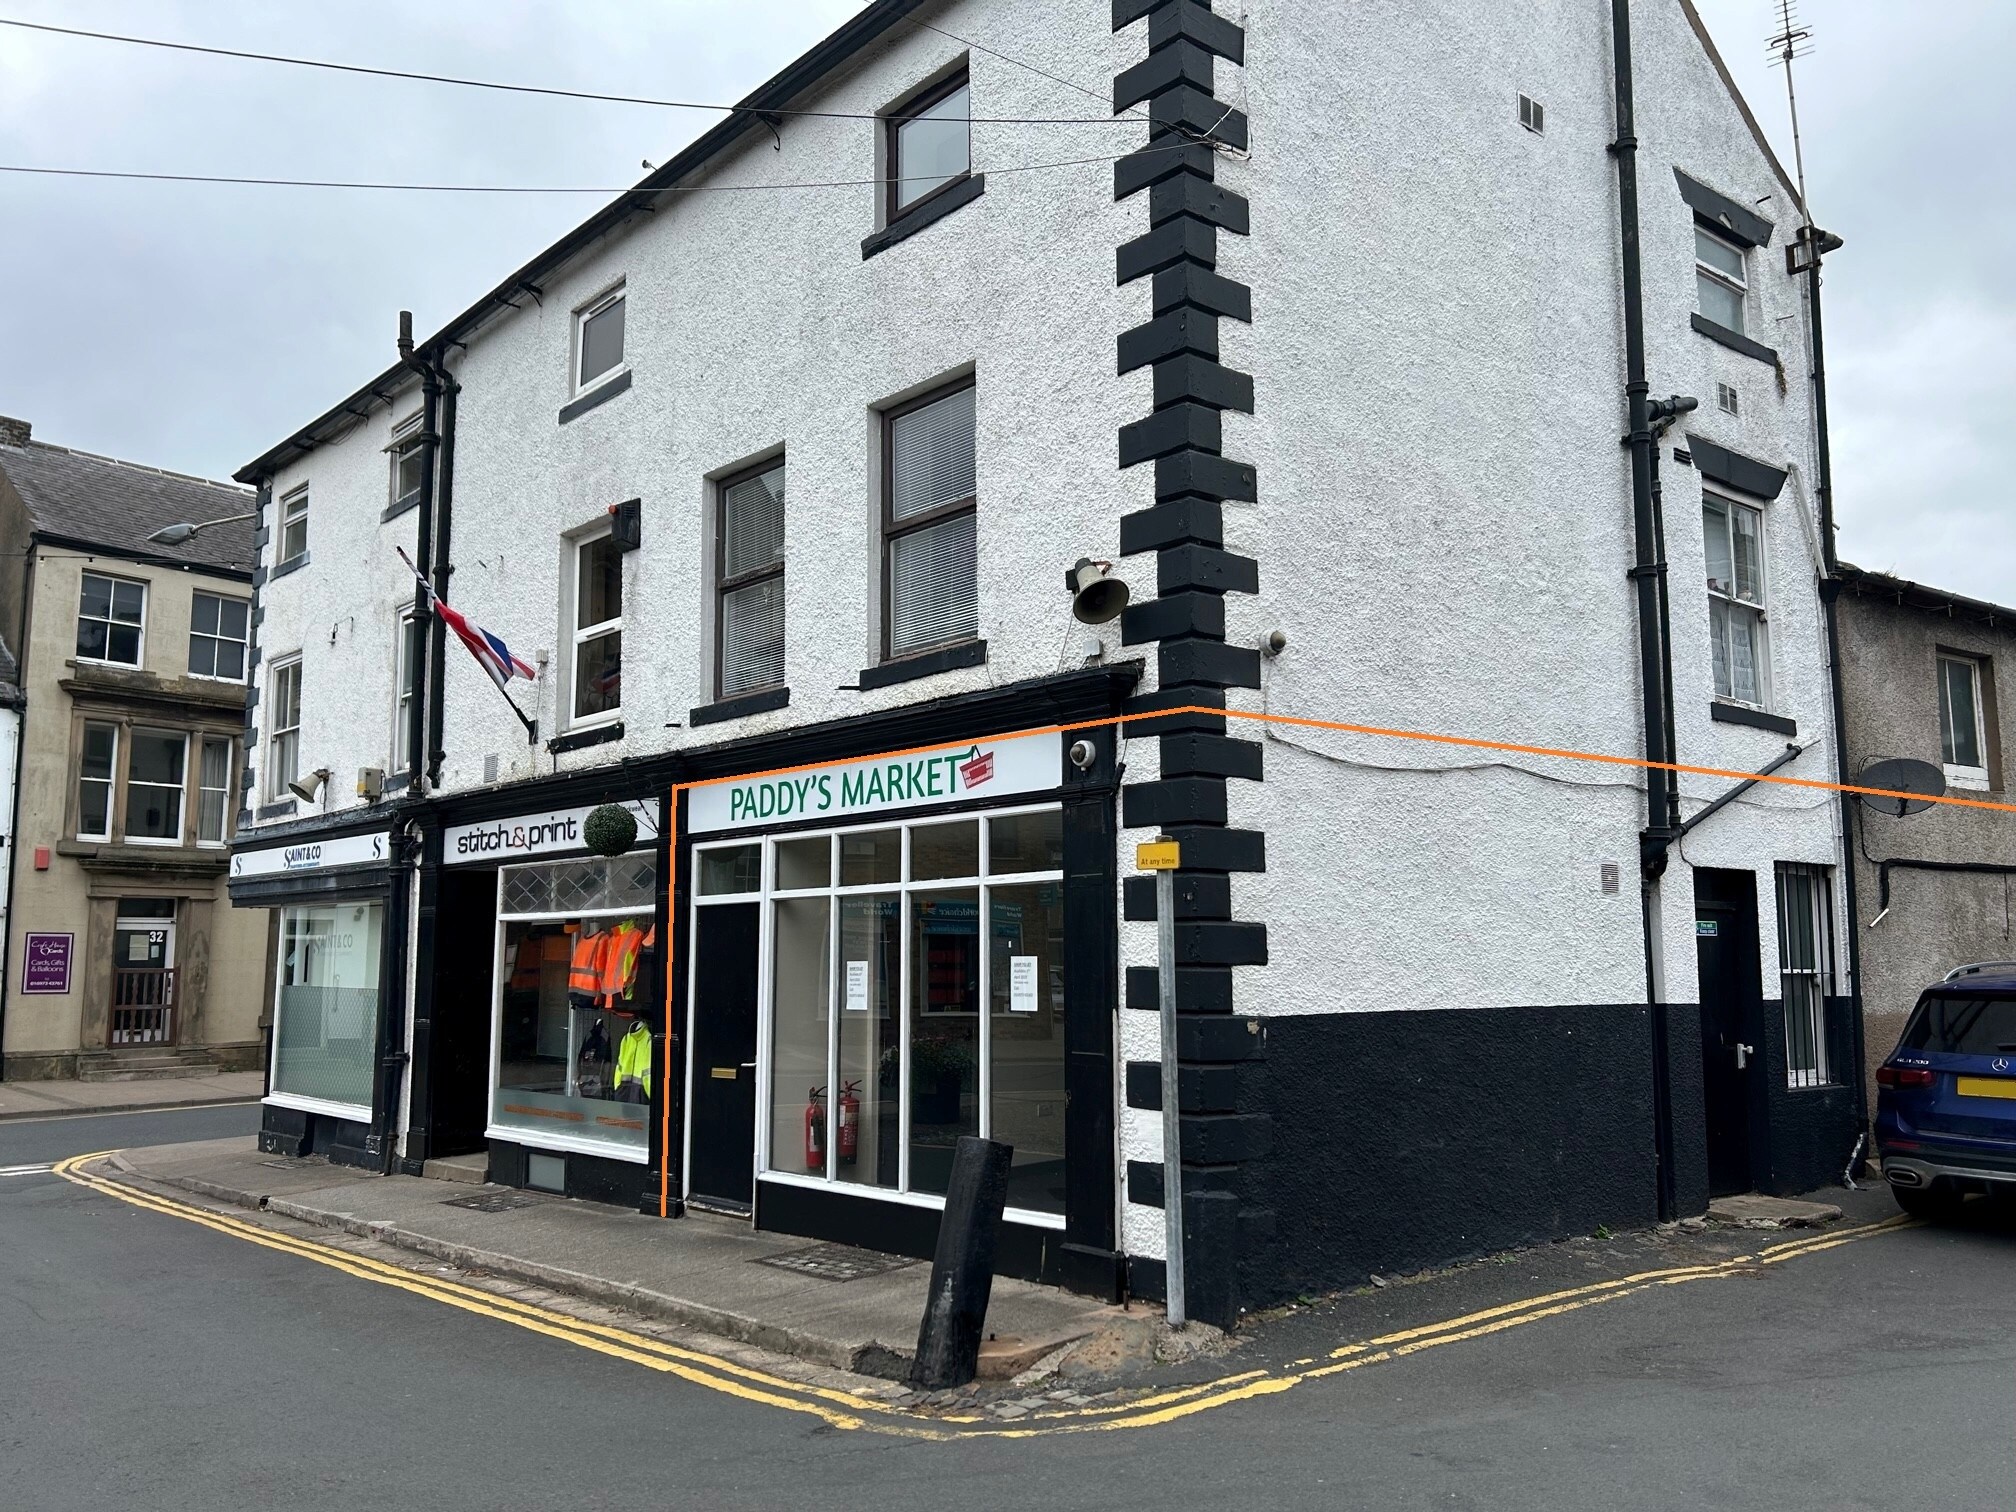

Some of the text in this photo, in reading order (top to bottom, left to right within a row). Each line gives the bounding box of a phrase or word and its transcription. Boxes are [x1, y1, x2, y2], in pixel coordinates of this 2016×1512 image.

[729, 753, 967, 822] PADDY'S MARKET
[1161, 857, 1175, 865] time
[149, 931, 164, 943] 32
